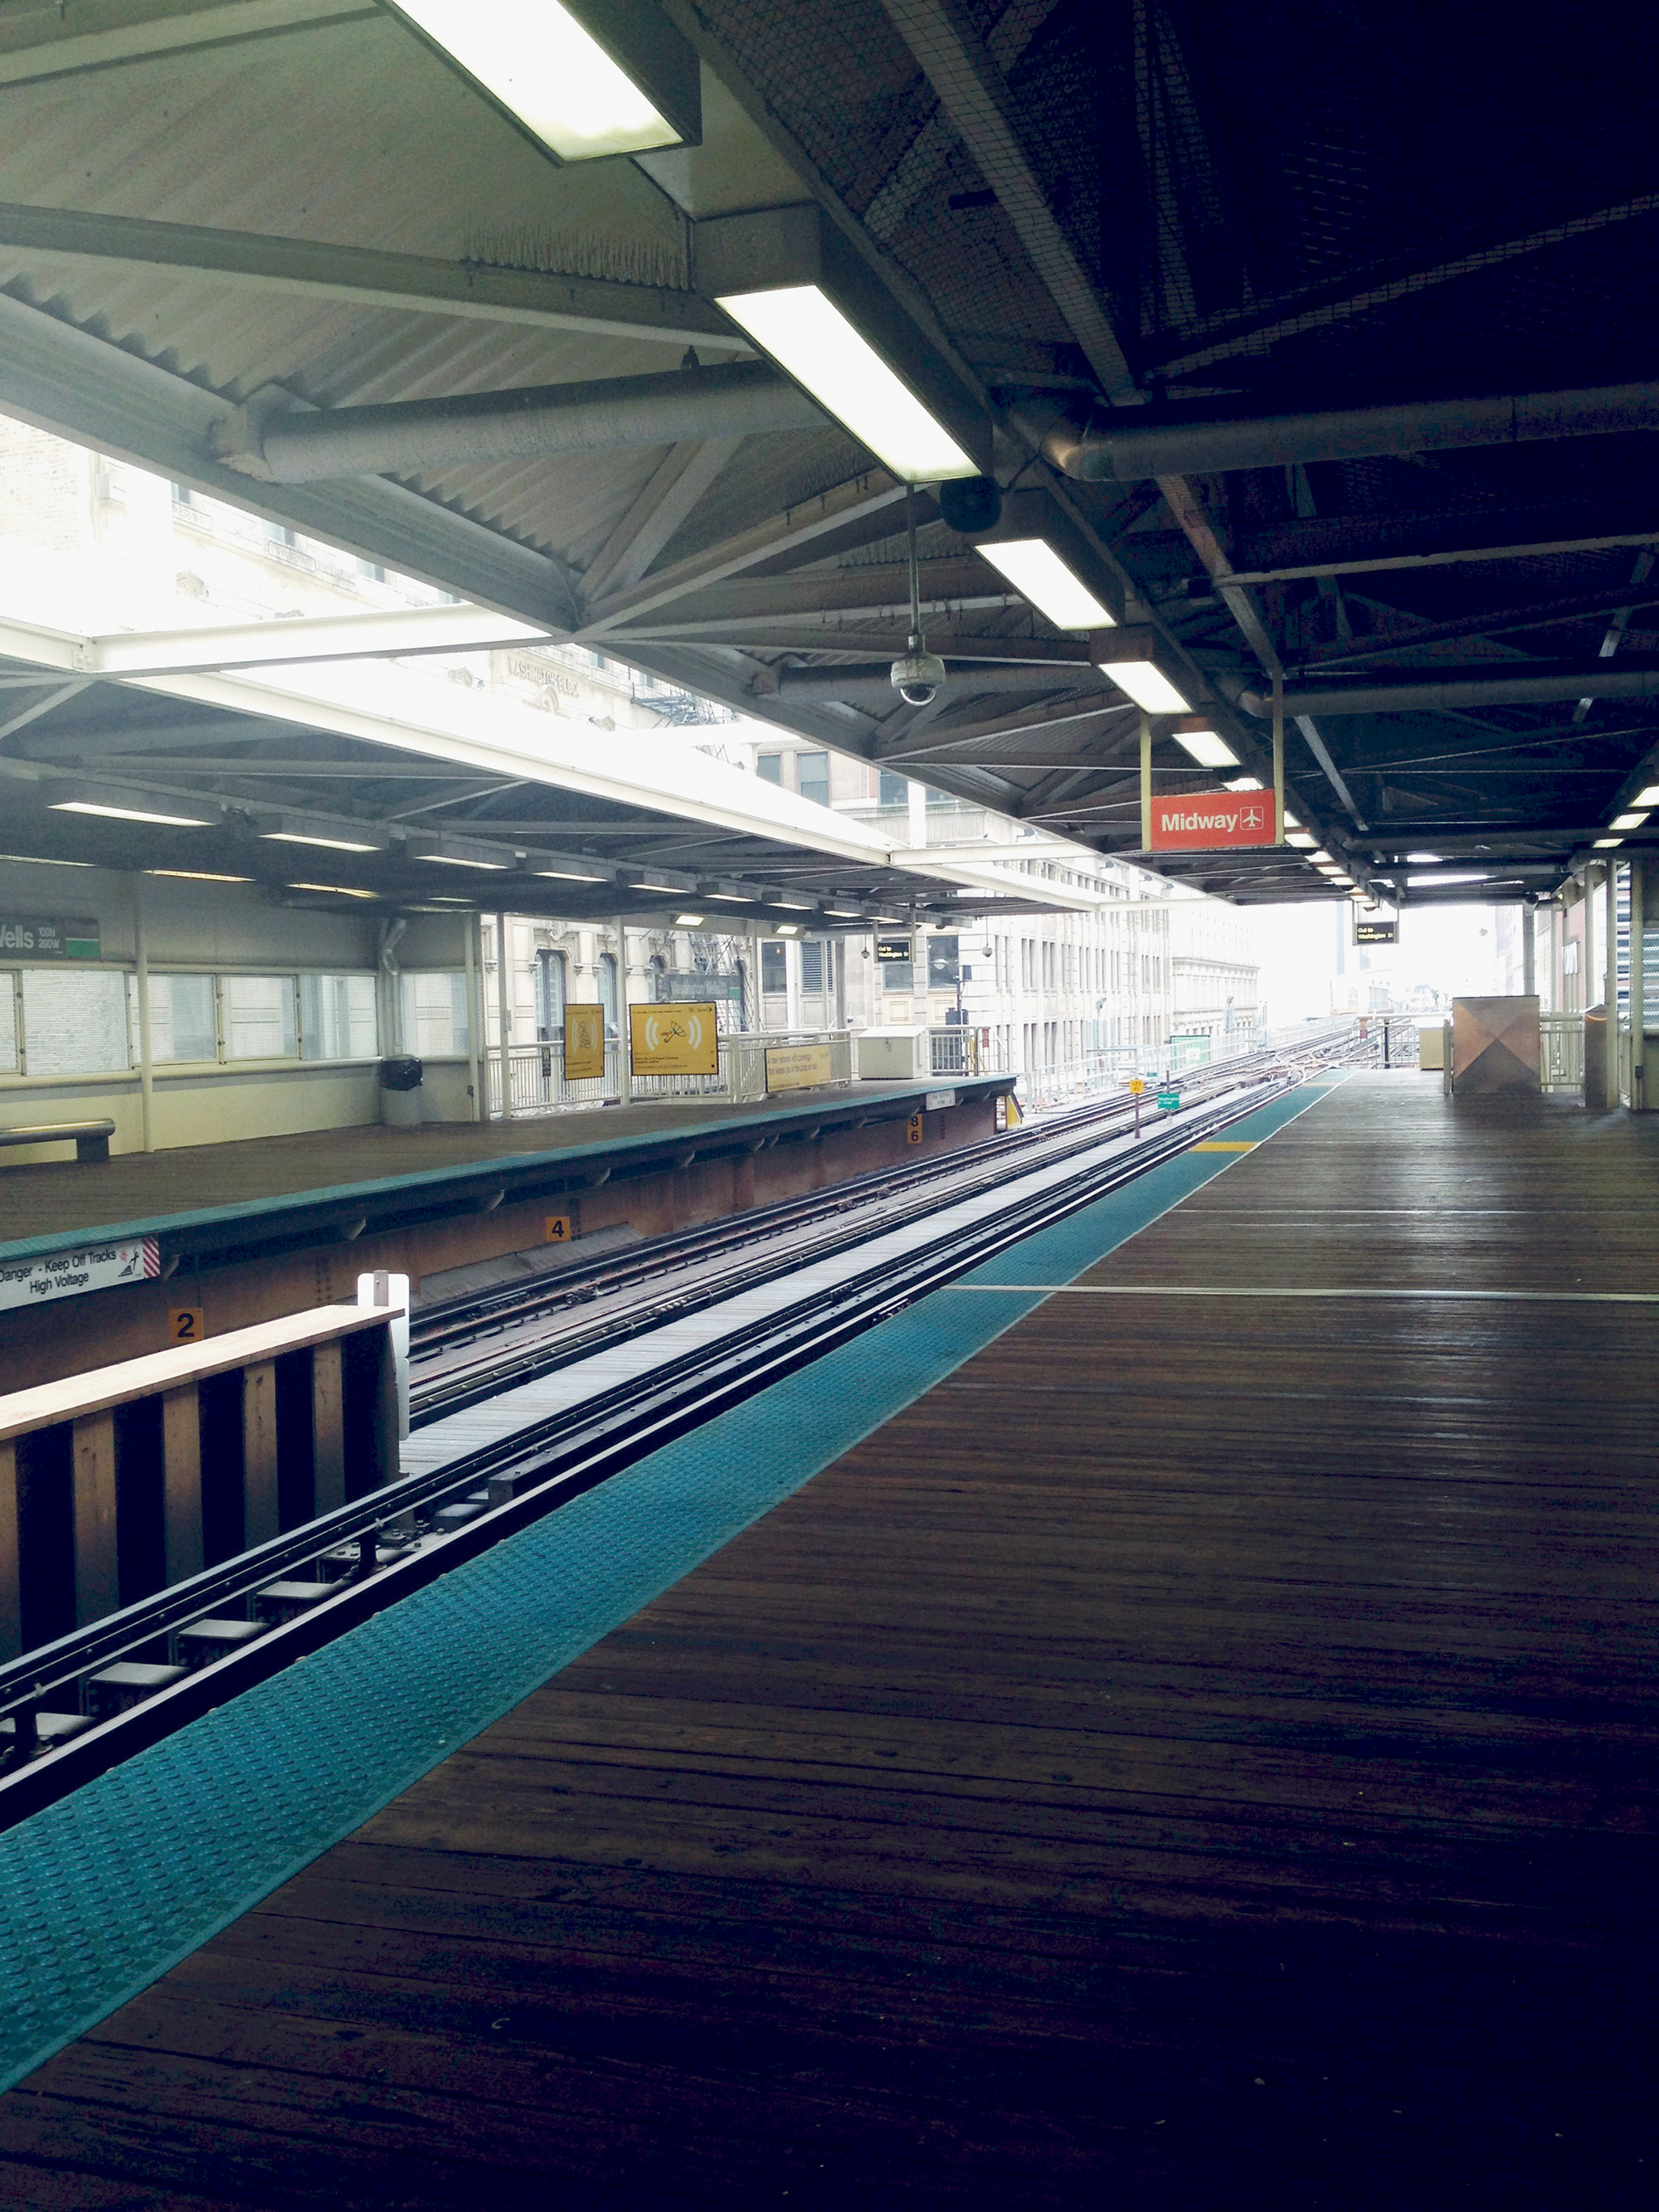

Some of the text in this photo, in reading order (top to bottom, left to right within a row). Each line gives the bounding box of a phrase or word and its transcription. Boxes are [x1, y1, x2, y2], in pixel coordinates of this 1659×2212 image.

[1161, 812, 1238, 833] Midway
[911, 1116, 919, 1127] 8
[911, 1130, 919, 1141] 6
[552, 1220, 564, 1237] 4
[0, 1266, 32, 1282] Danger
[44, 1259, 70, 1273] Keep
[71, 1252, 86, 1268] Off
[88, 1249, 117, 1265] Tracks
[29, 1271, 89, 1295] High Voltage
[177, 1313, 195, 1338] 2
